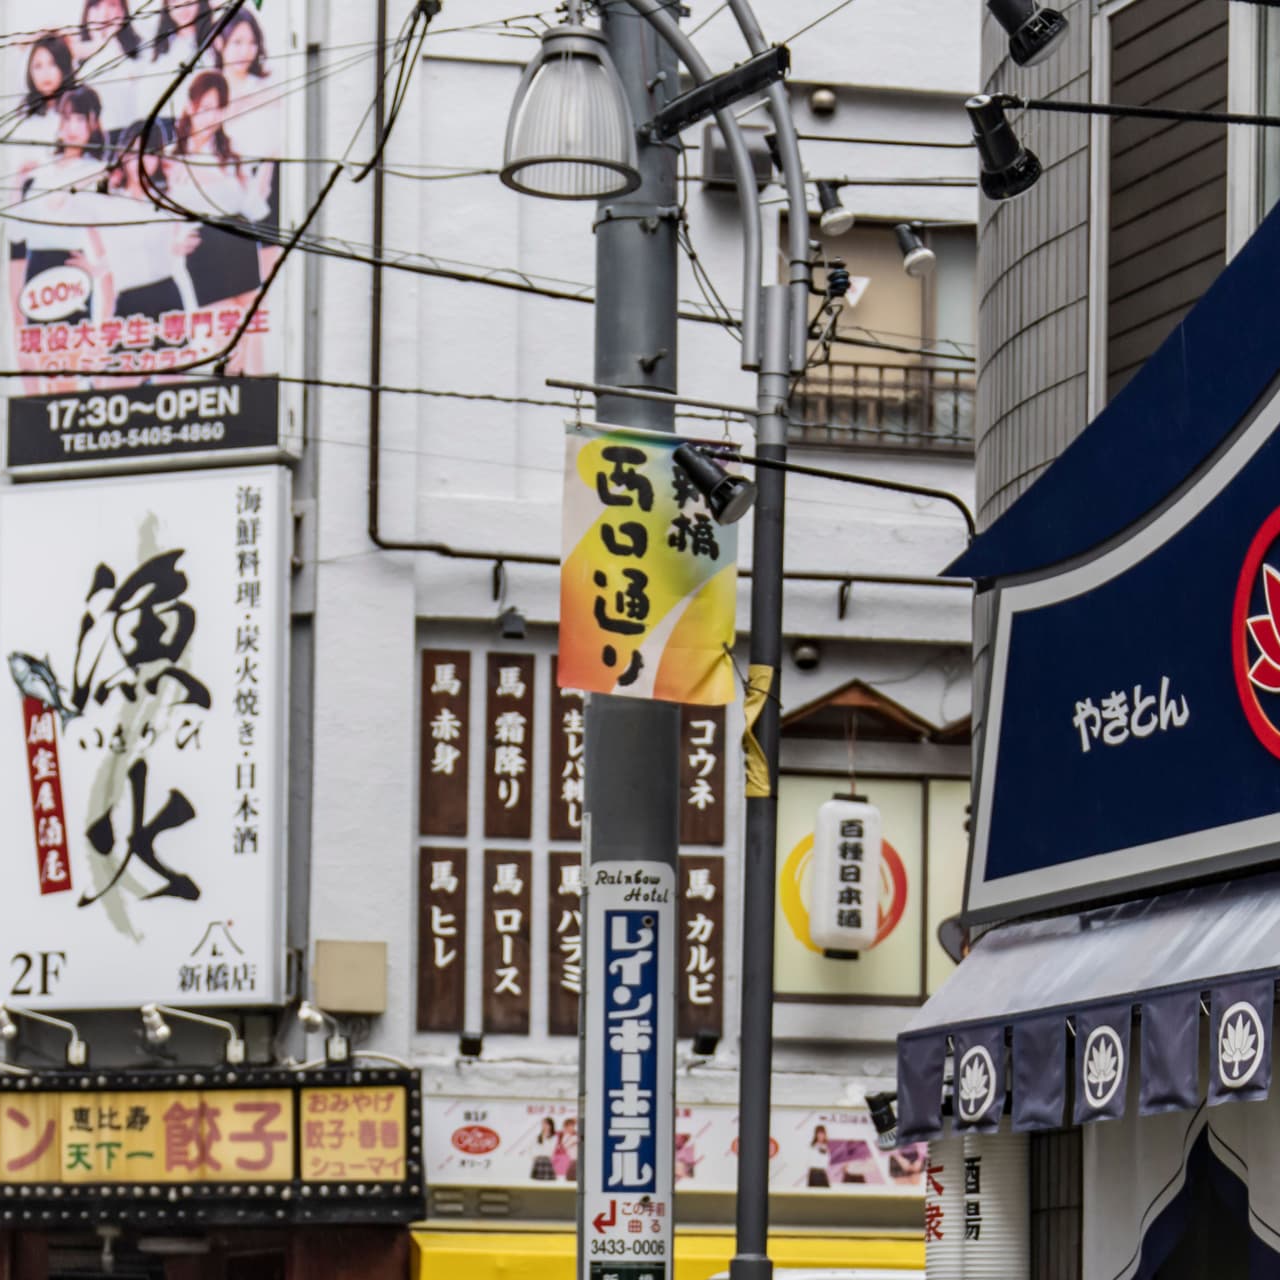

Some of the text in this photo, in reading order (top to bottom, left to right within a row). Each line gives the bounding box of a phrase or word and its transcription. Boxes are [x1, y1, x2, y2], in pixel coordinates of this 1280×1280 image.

[27, 282, 84, 311] 100%
[594, 445, 654, 687] 西口通り
[71, 548, 212, 908] 漁火
[1072, 676, 1190, 753] やきとん
[687, 719, 717, 810] コウネ
[595, 868, 661, 885] Rainbow
[624, 887, 669, 903] Hotel
[10, 953, 67, 997] 2F
[178, 965, 256, 994] 新橋店
[609, 914, 654, 1186] レインボーホテル
[308, 1090, 395, 1113] おみやげ
[162, 1099, 289, 1174] 餃子
[66, 1142, 155, 1171] 天下一
[591, 1239, 665, 1255] 3433-0006
